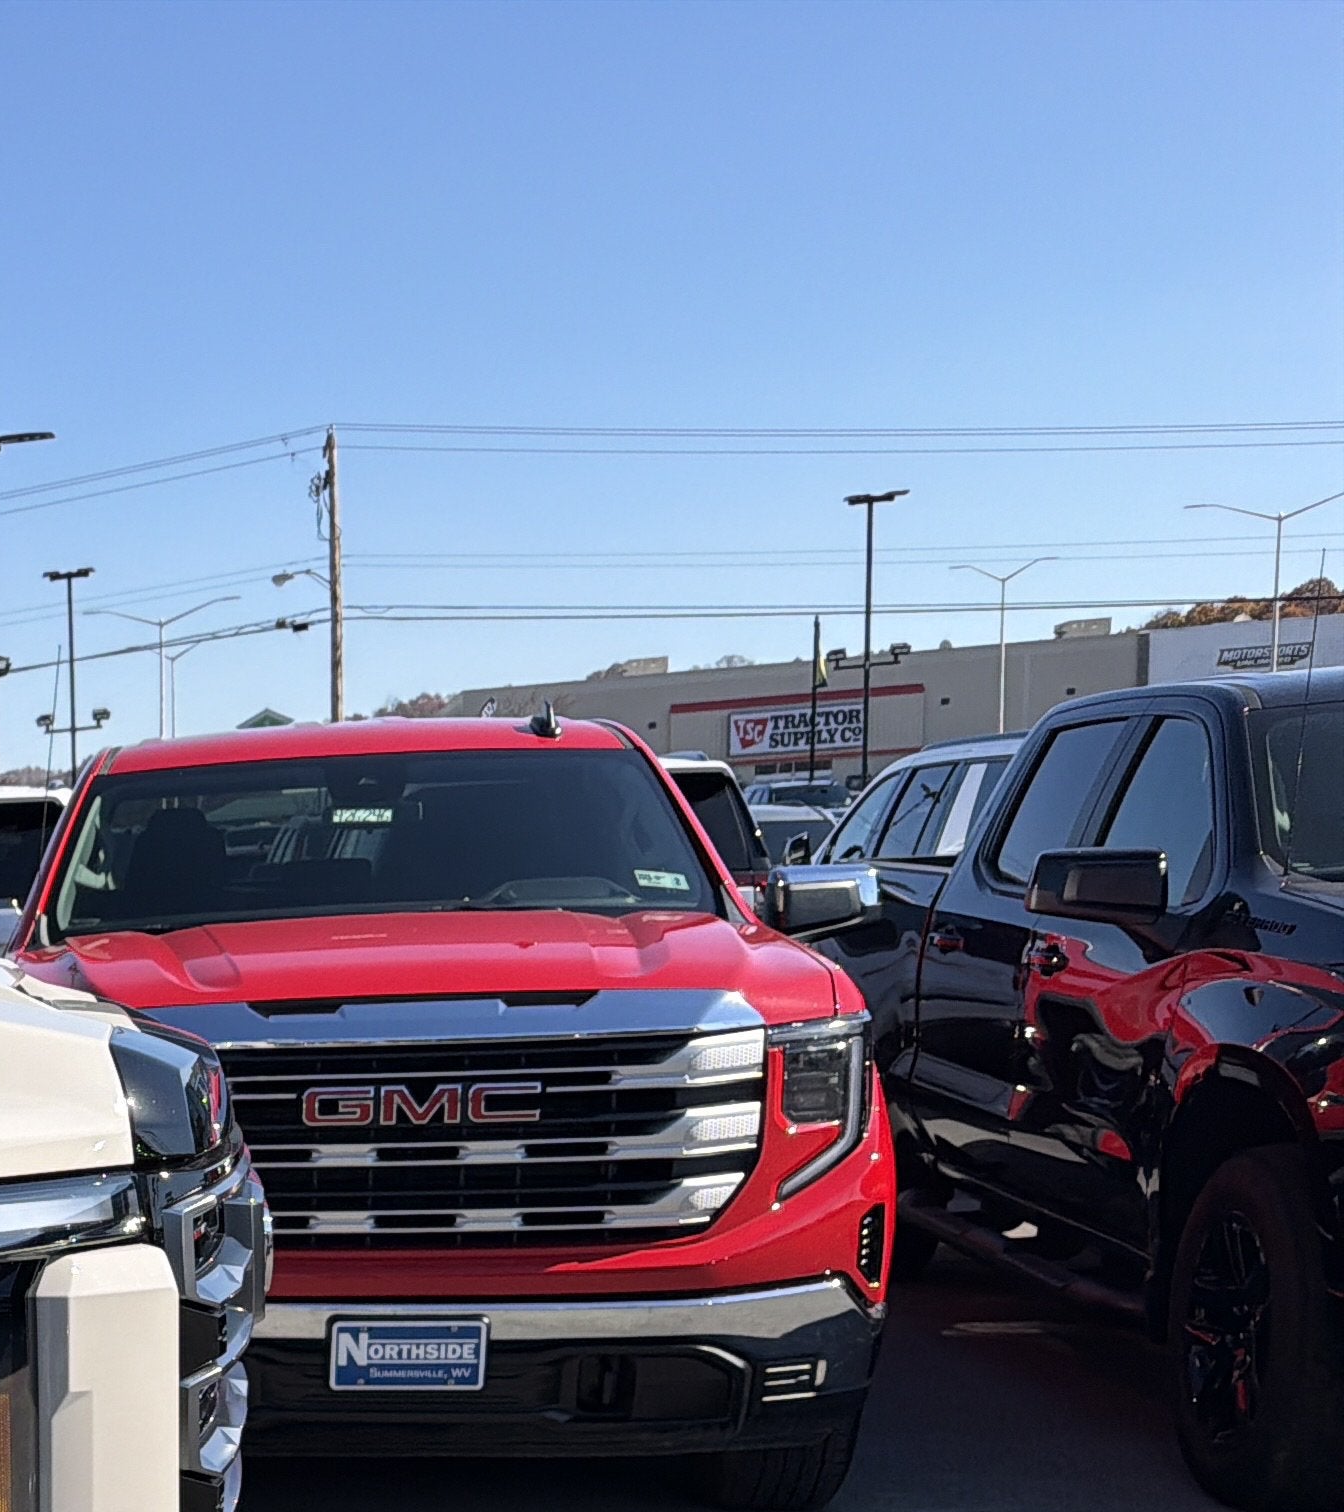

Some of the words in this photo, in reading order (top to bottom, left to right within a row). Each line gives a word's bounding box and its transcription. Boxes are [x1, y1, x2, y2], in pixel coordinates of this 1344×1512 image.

[1220, 644, 1310, 663] MOTORSORTS
[770, 708, 862, 731] TRACTOR
[736, 720, 764, 744] TSC
[768, 727, 840, 749] SUPPLY
[302, 1082, 542, 1126] GMC
[338, 1332, 476, 1367] NORTHSIDE
[450, 1367, 472, 1378] WV
